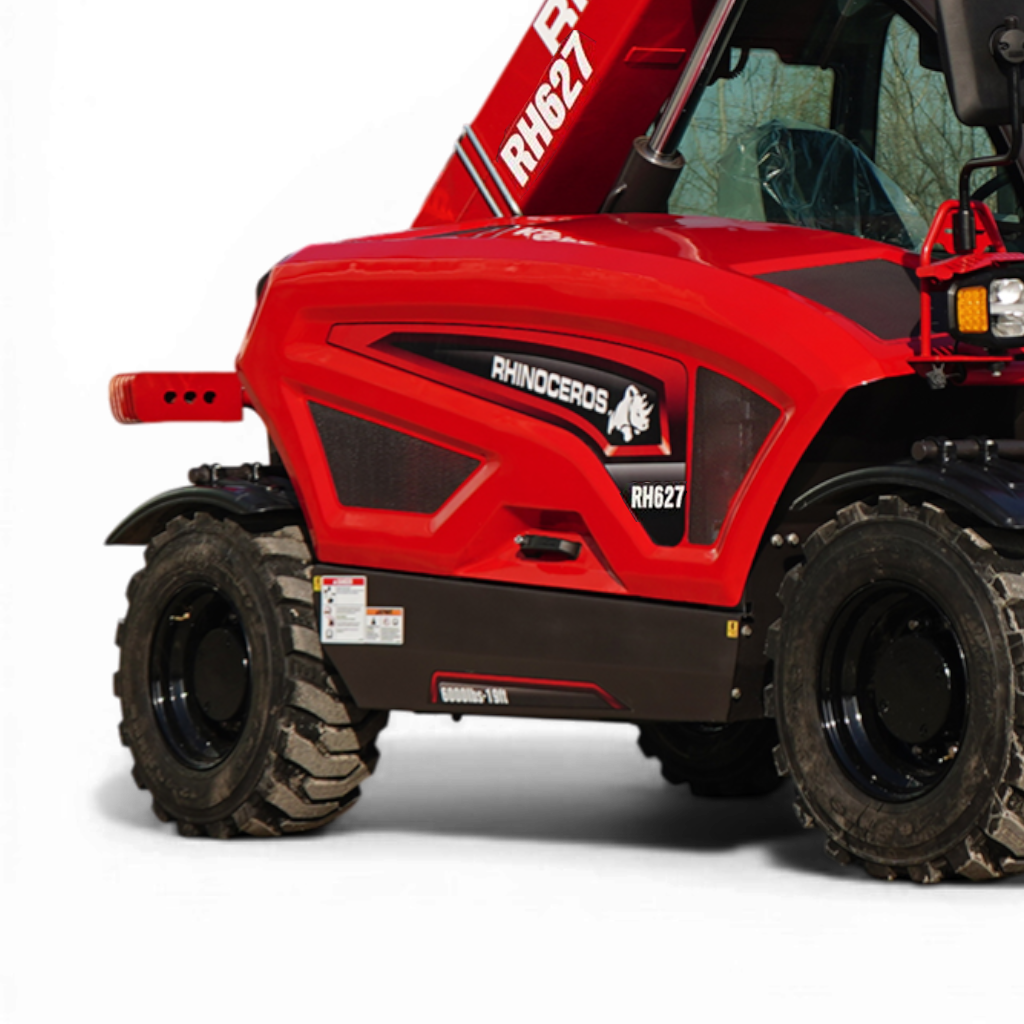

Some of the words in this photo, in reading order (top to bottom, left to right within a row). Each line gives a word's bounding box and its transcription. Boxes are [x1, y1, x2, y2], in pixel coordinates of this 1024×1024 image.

[501, 30, 593, 186] RH627
[491, 355, 608, 414] RHINOCEROS
[631, 485, 685, 509] RH627
